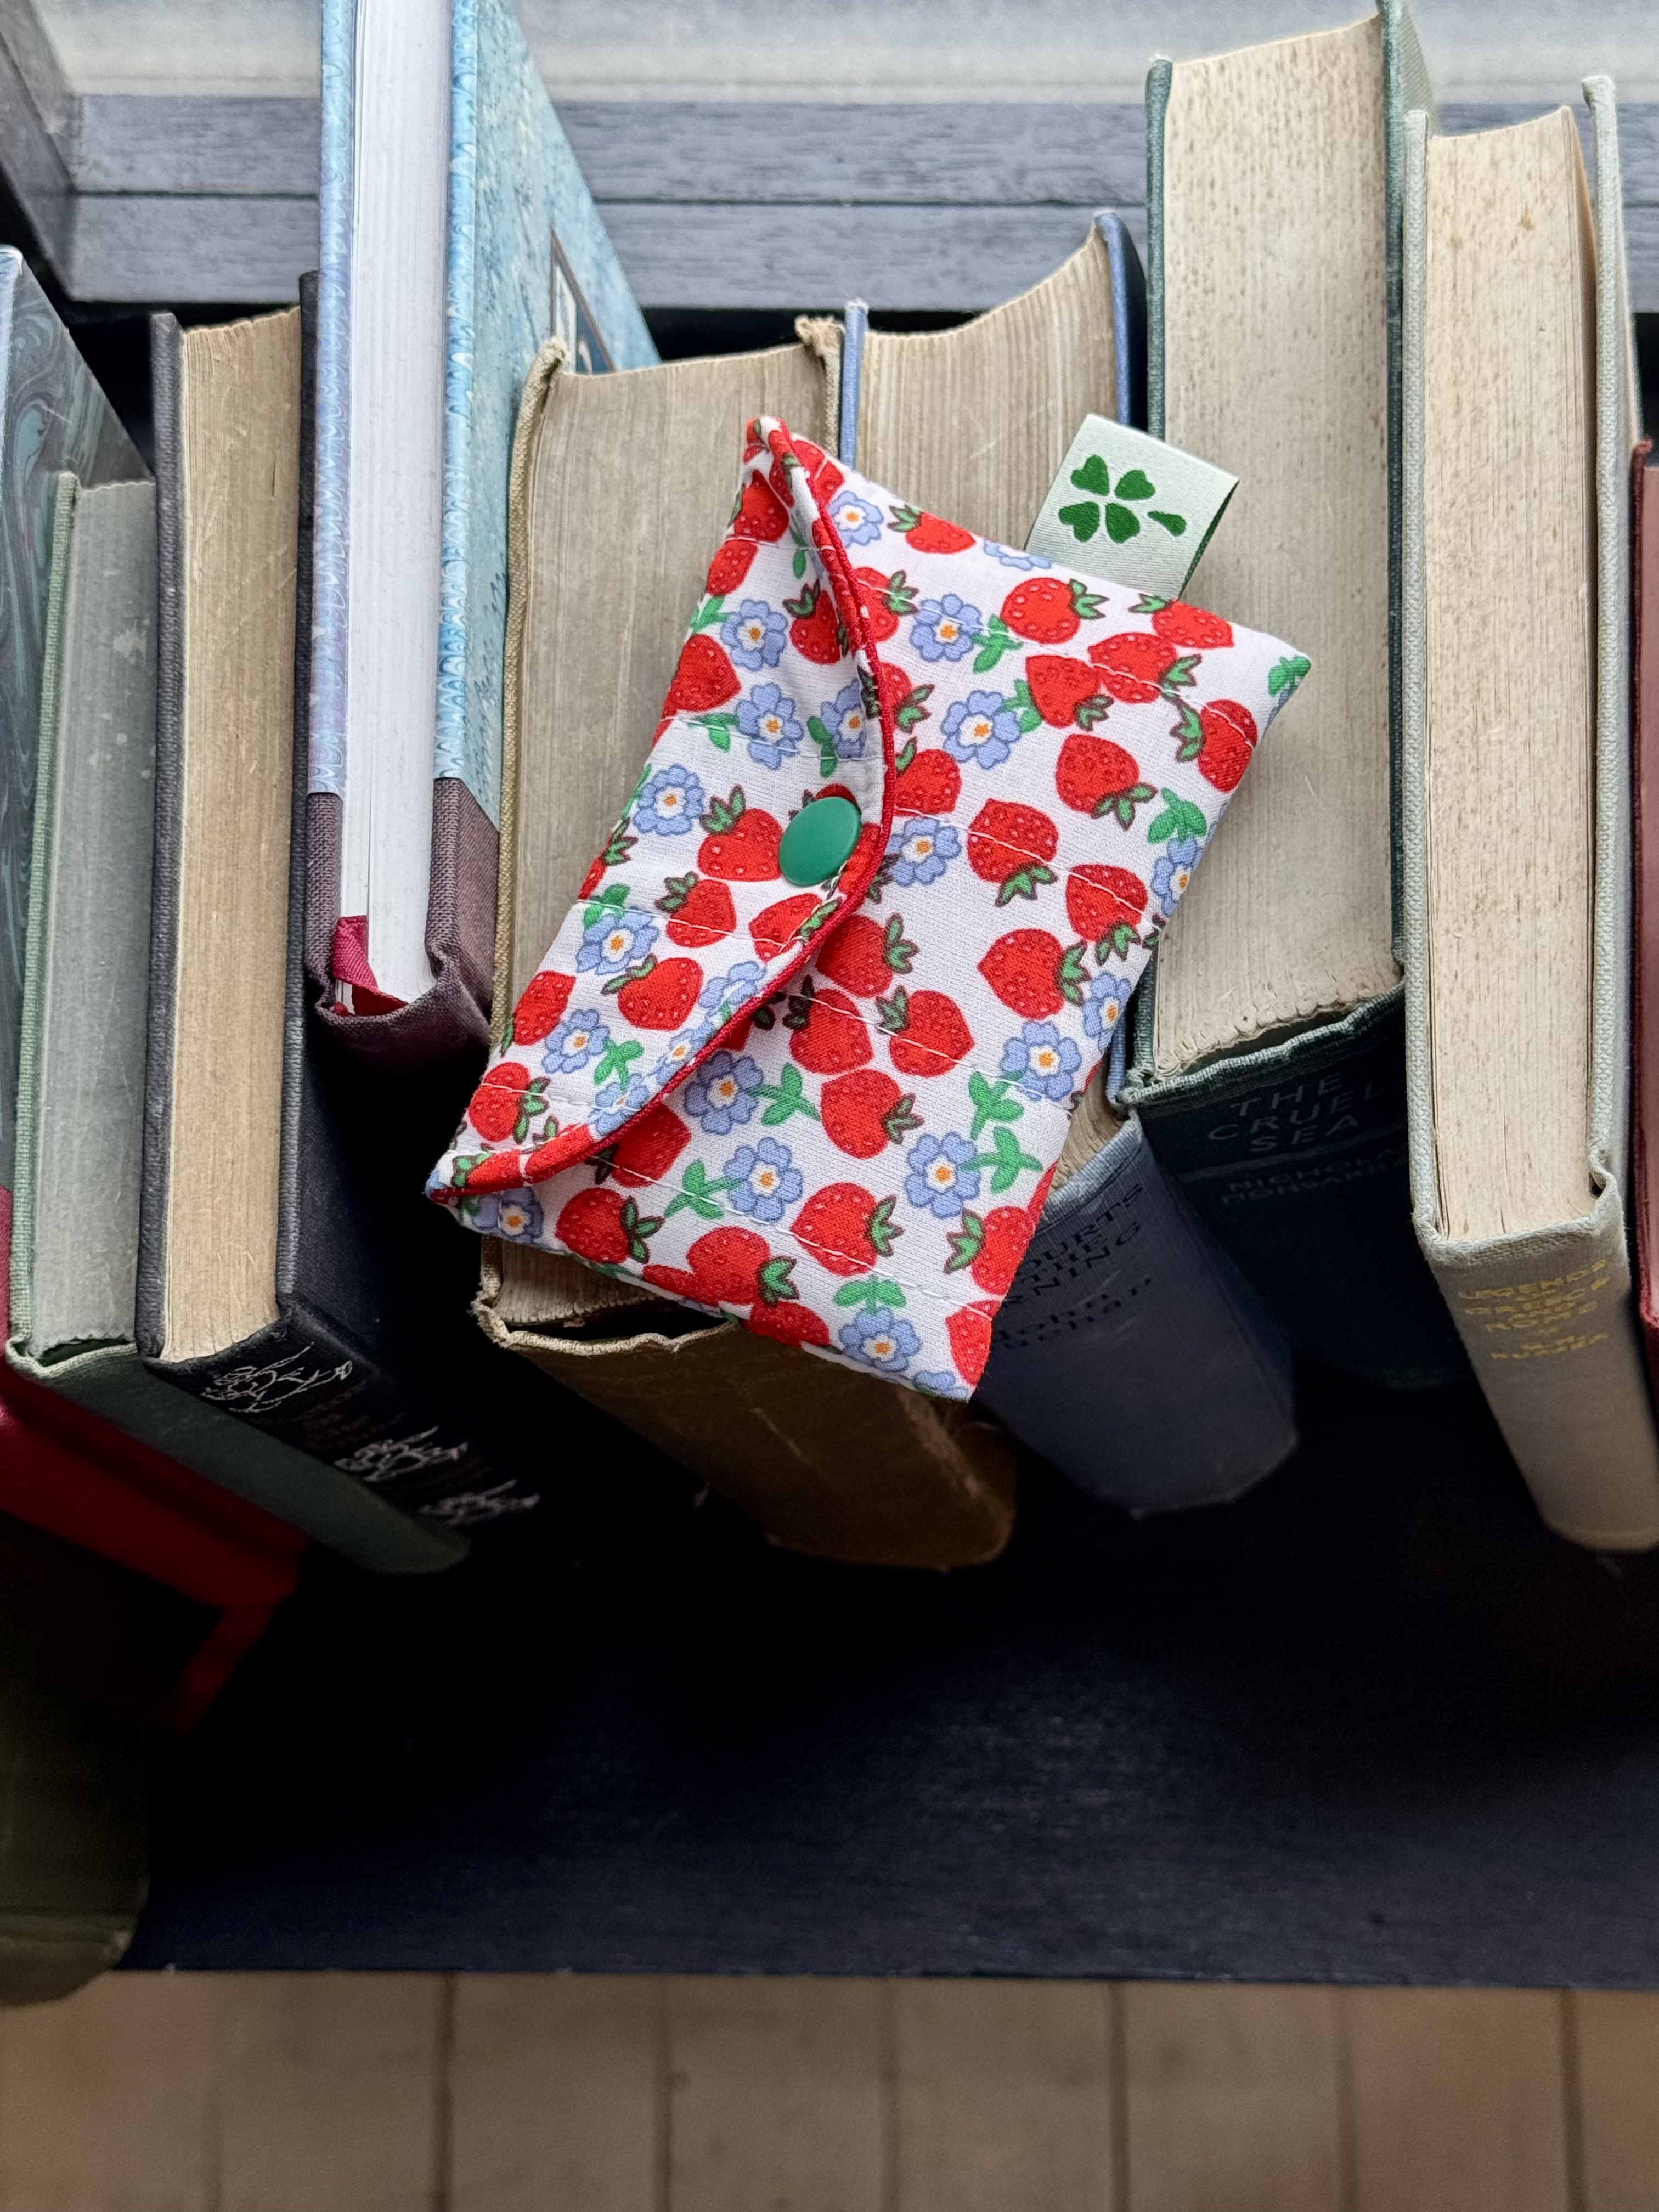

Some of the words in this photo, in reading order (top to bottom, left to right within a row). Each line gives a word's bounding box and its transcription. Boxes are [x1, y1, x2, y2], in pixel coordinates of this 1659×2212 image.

[1207, 1081, 1384, 1141] CRUEL
[1229, 1070, 1344, 1117] THE
[1248, 1113, 1359, 1153] SEA
[1017, 1184, 1142, 1277] OURTS
[1002, 1222, 1141, 1309] RNING
[1020, 1234, 1107, 1283] THE
[1458, 1259, 1609, 1299] LEGENDS
[1465, 1276, 1611, 1316] GREECE
[1486, 1301, 1598, 1333] ROME
